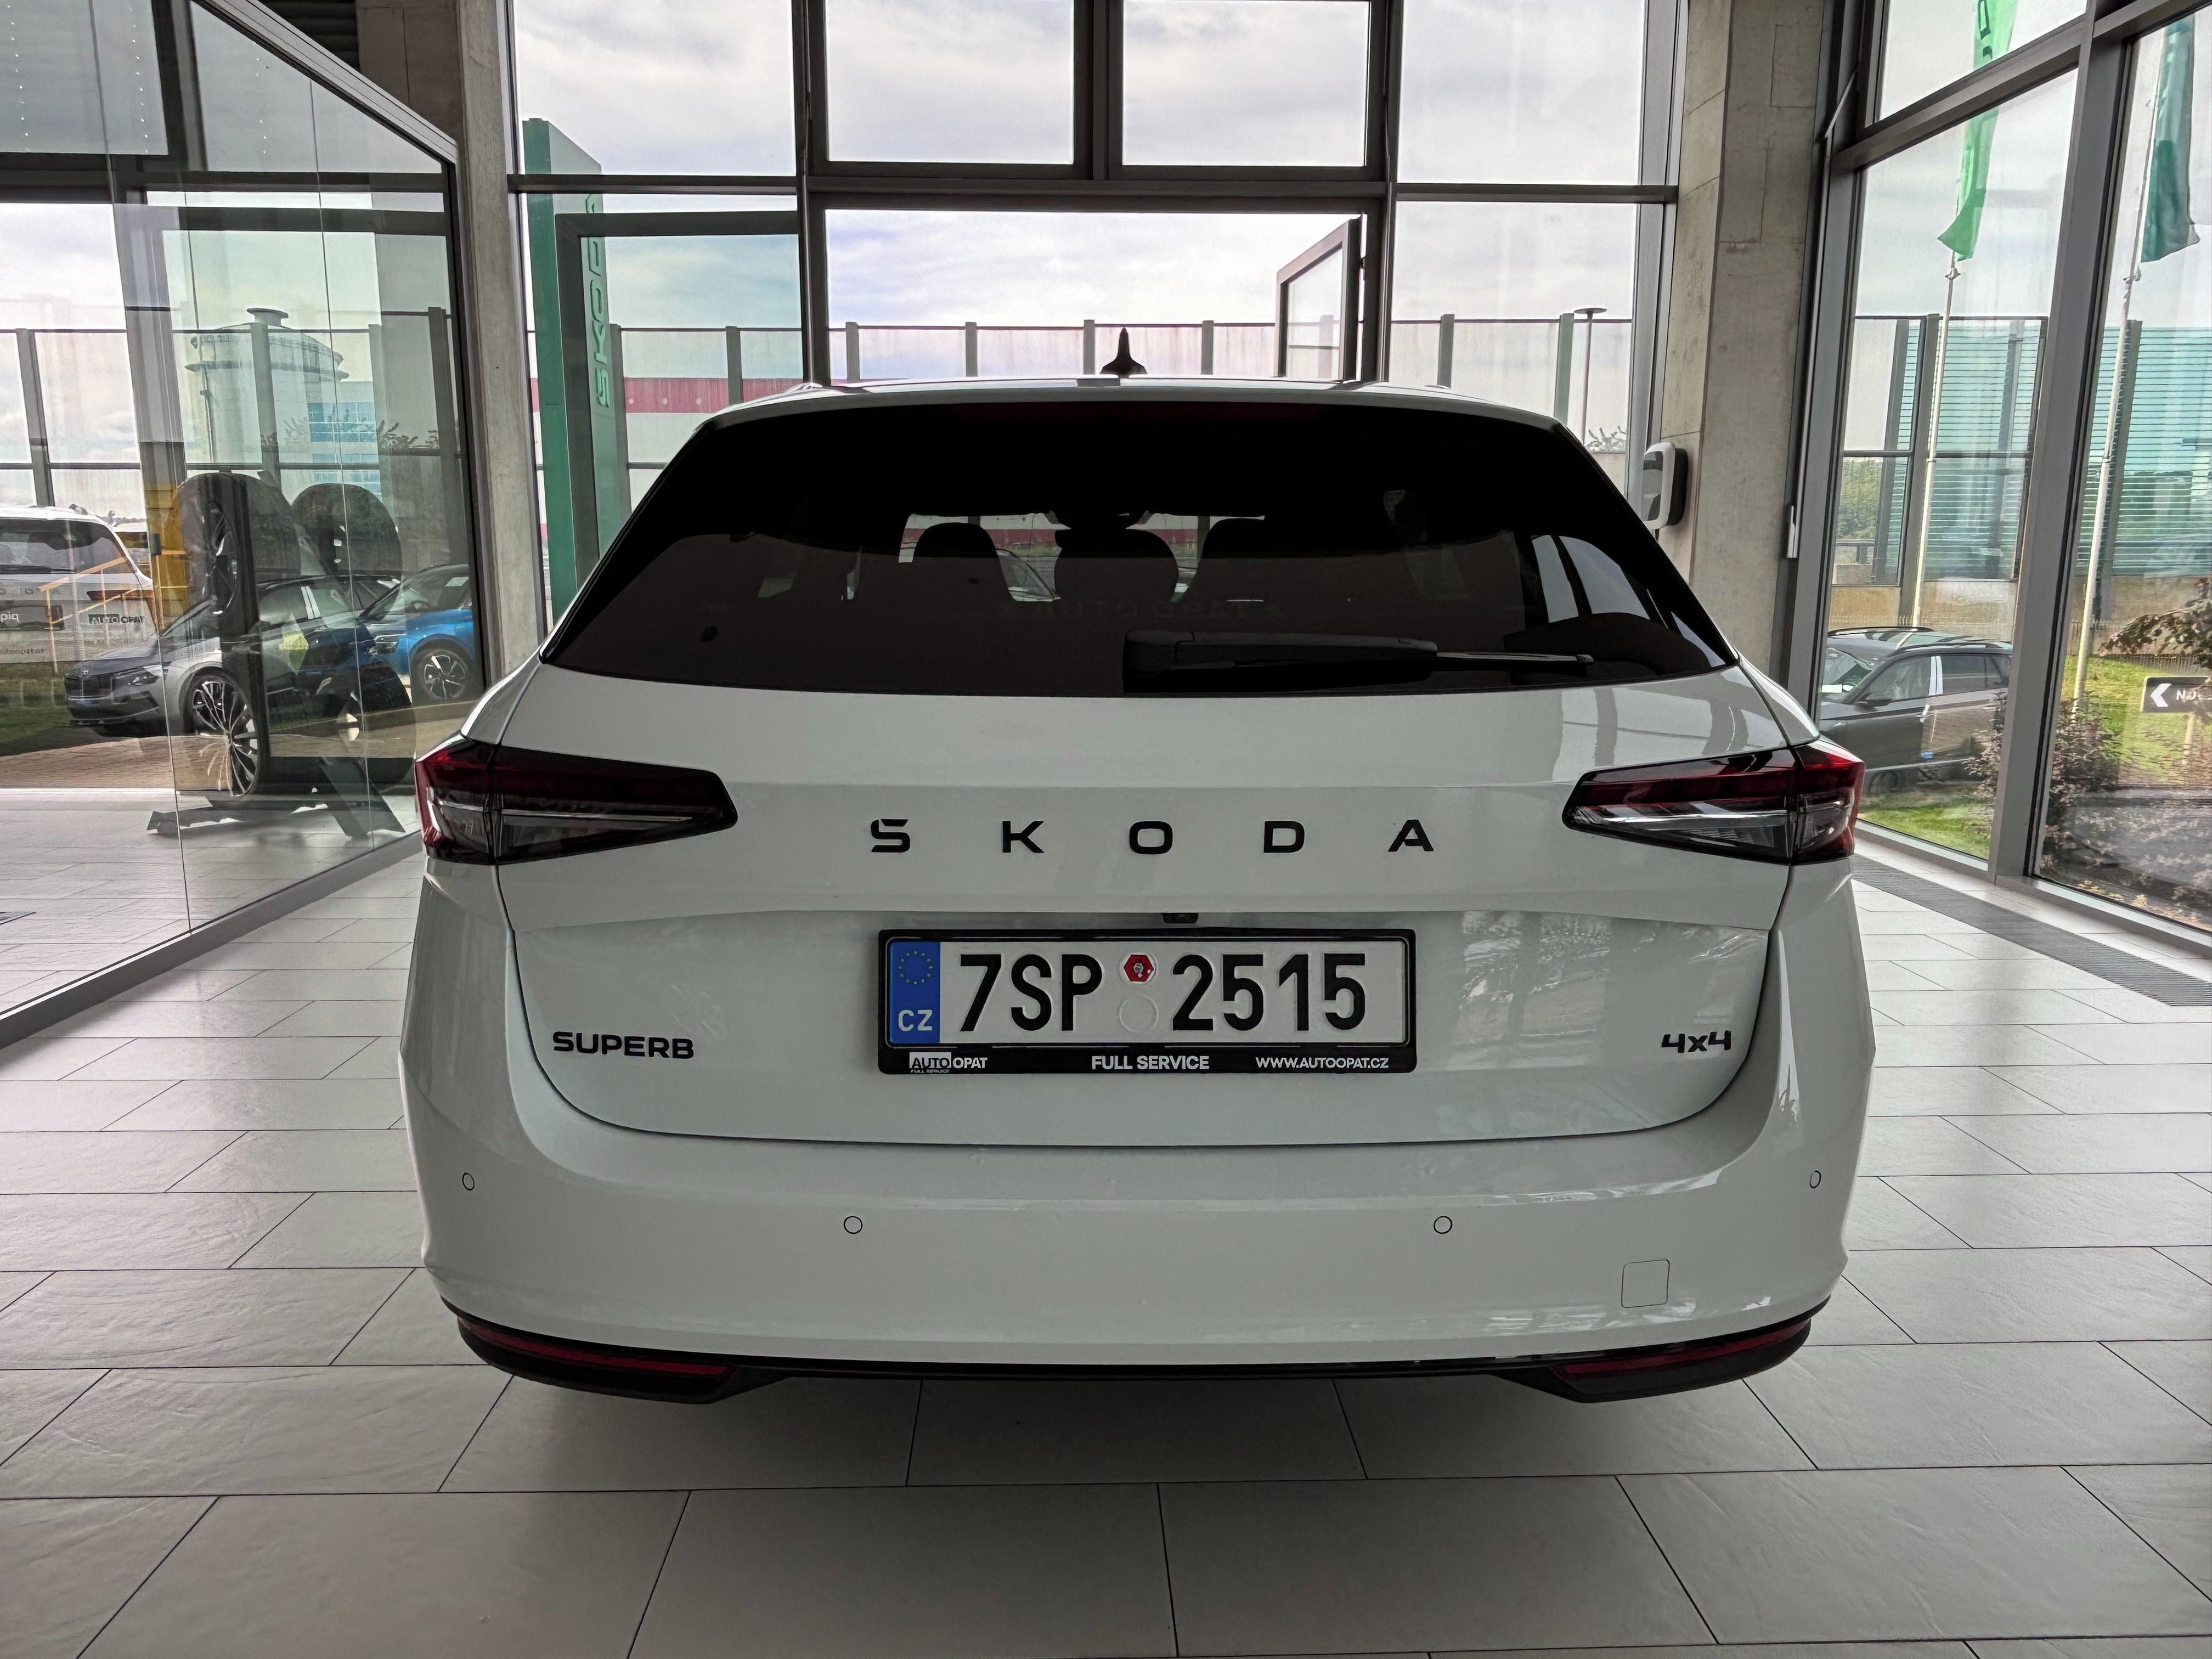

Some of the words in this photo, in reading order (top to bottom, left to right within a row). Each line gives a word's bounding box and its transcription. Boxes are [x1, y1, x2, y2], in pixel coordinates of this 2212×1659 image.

[960, 953, 1102, 1031] 7SP
[1173, 953, 1365, 1031] 2515
[898, 1009, 932, 1031] CZ
[553, 1031, 694, 1059] SUPERB
[1662, 1030, 1731, 1053] 4x4
[1092, 1056, 1132, 1070] FULL
[1137, 1056, 1210, 1070] SERVICE
[1255, 1057, 1389, 1069] WWW.AUTOOPAT.CZ
